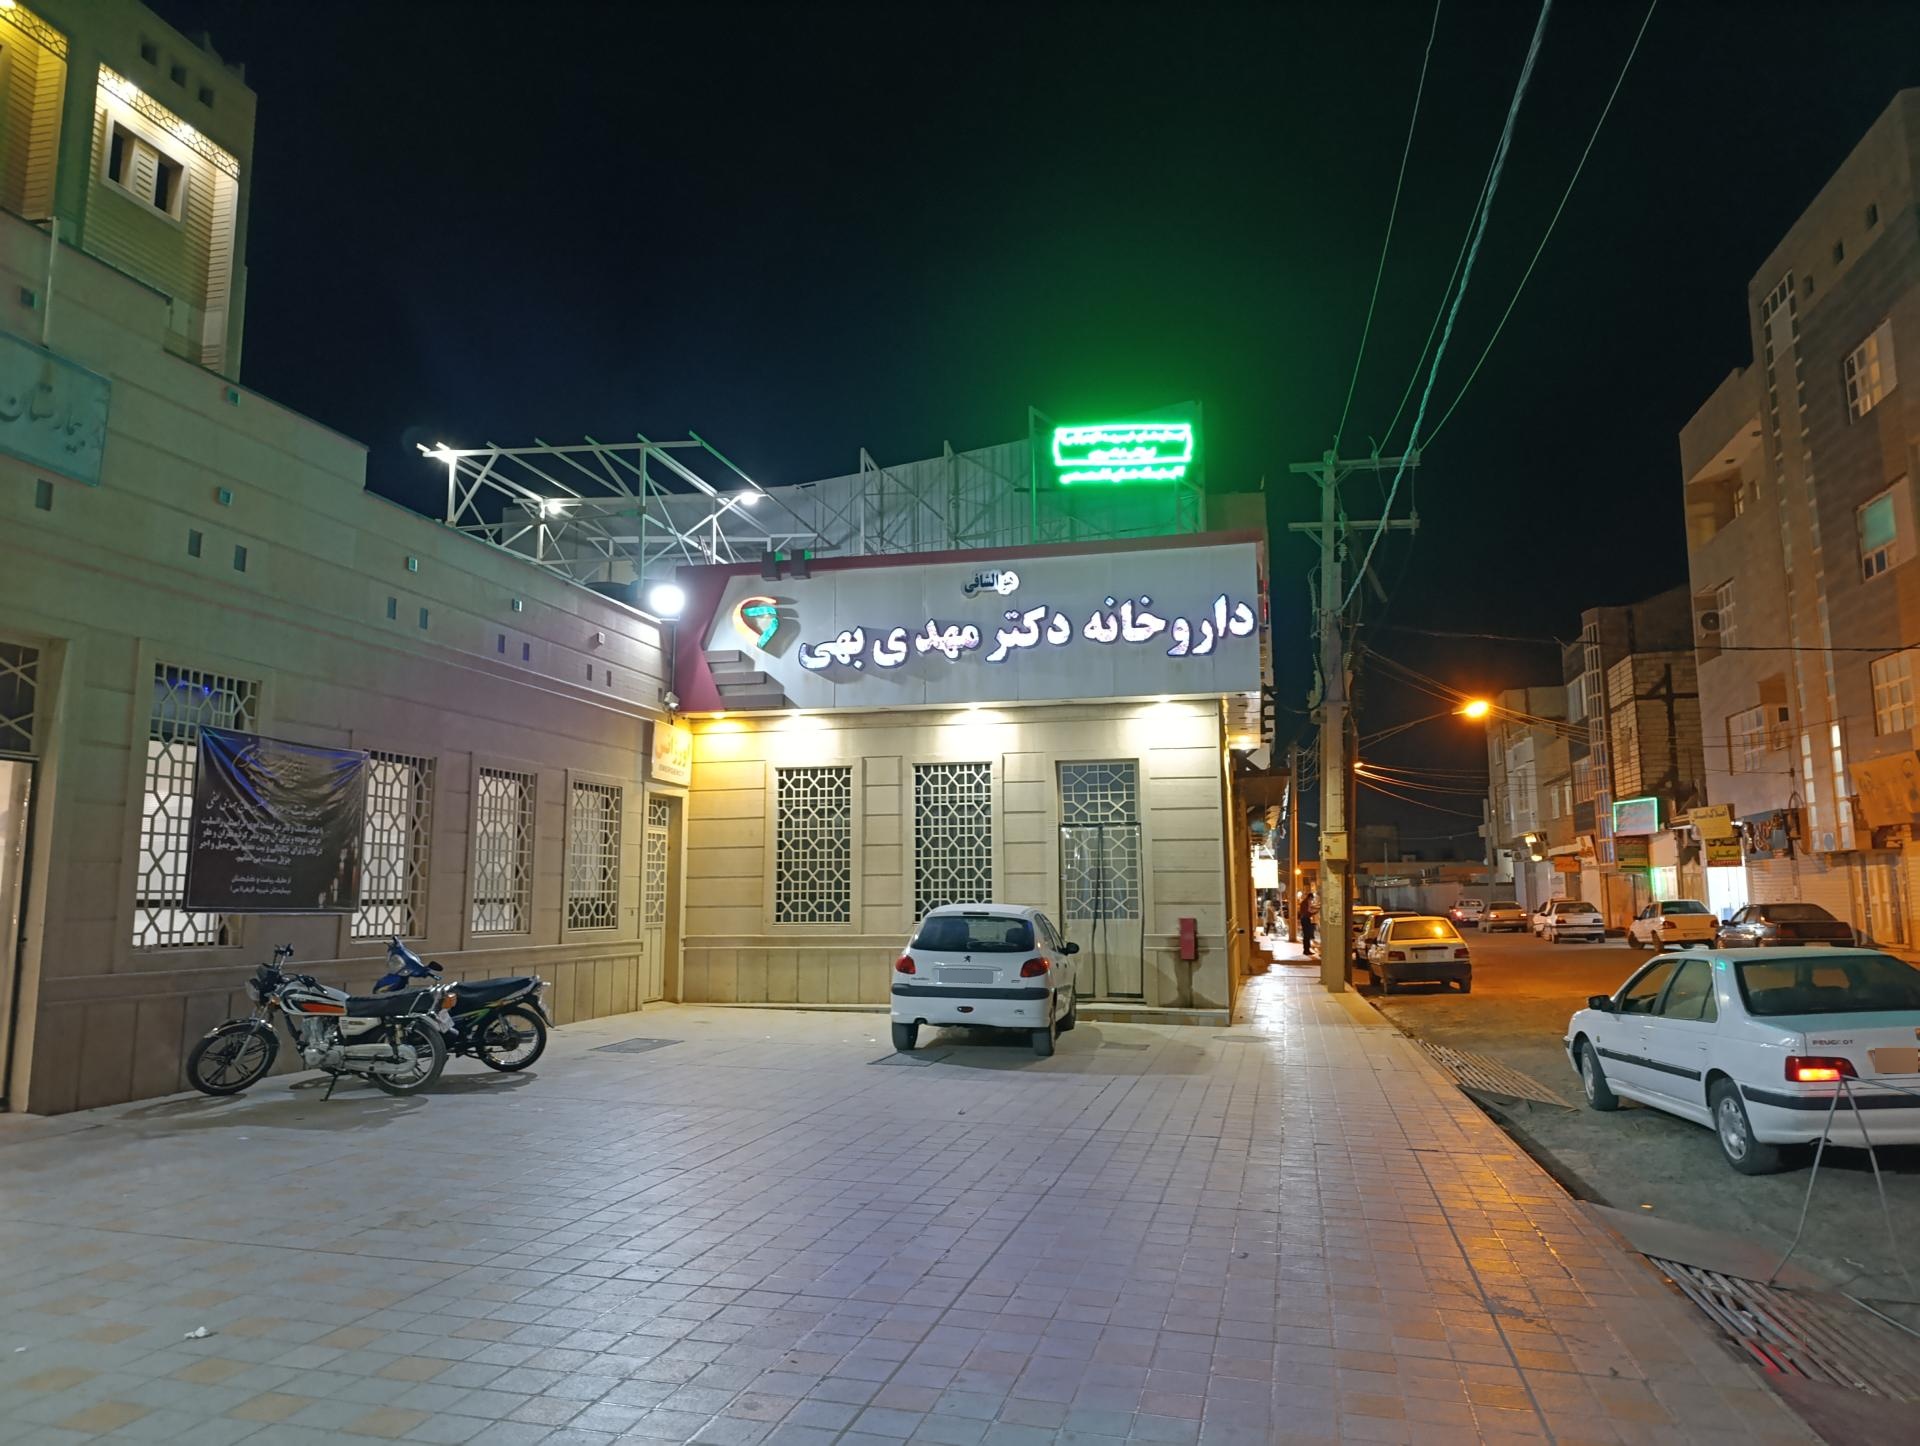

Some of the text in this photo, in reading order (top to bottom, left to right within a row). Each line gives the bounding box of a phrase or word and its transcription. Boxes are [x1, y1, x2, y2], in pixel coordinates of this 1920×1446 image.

[798, 594, 1258, 670] داروخانه دکتر مهدی بهی
